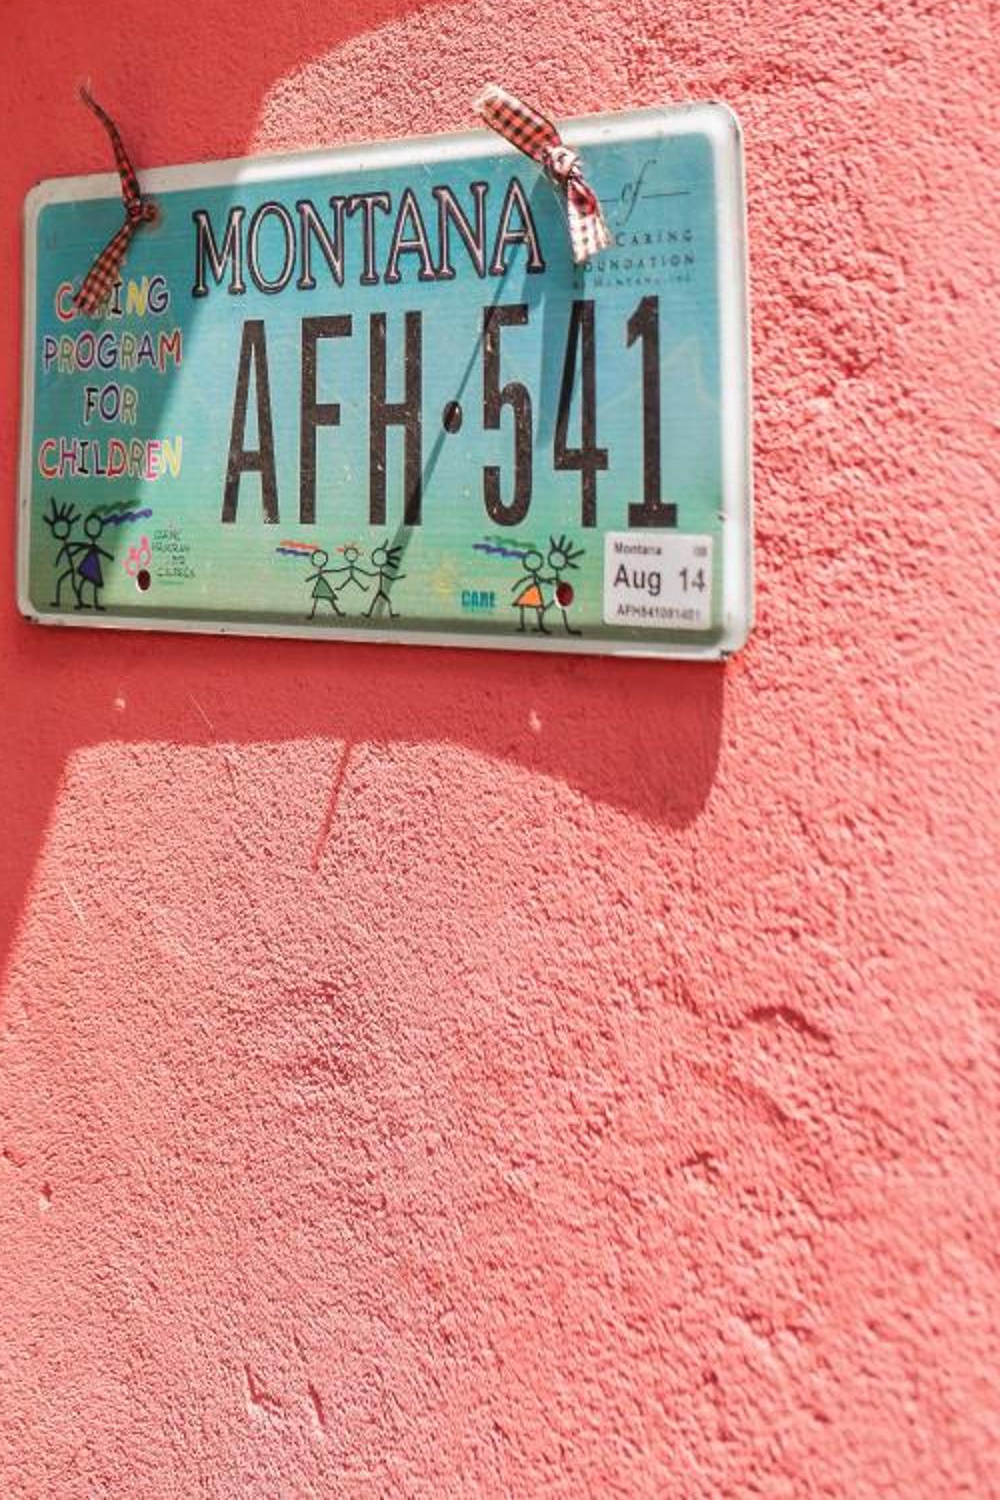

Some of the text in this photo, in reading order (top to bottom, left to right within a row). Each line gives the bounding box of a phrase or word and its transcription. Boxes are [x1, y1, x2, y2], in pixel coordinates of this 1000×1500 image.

[191, 176, 545, 298] MONTANA
[615, 229, 693, 247] CARING
[574, 253, 695, 273] OUNDATION
[57, 276, 169, 322] CING
[43, 327, 183, 373] PROGRAM
[83, 382, 138, 425] FOR
[38, 435, 183, 481] CHILDREN
[614, 542, 662, 555] Montana
[613, 564, 706, 597] Aug 14
